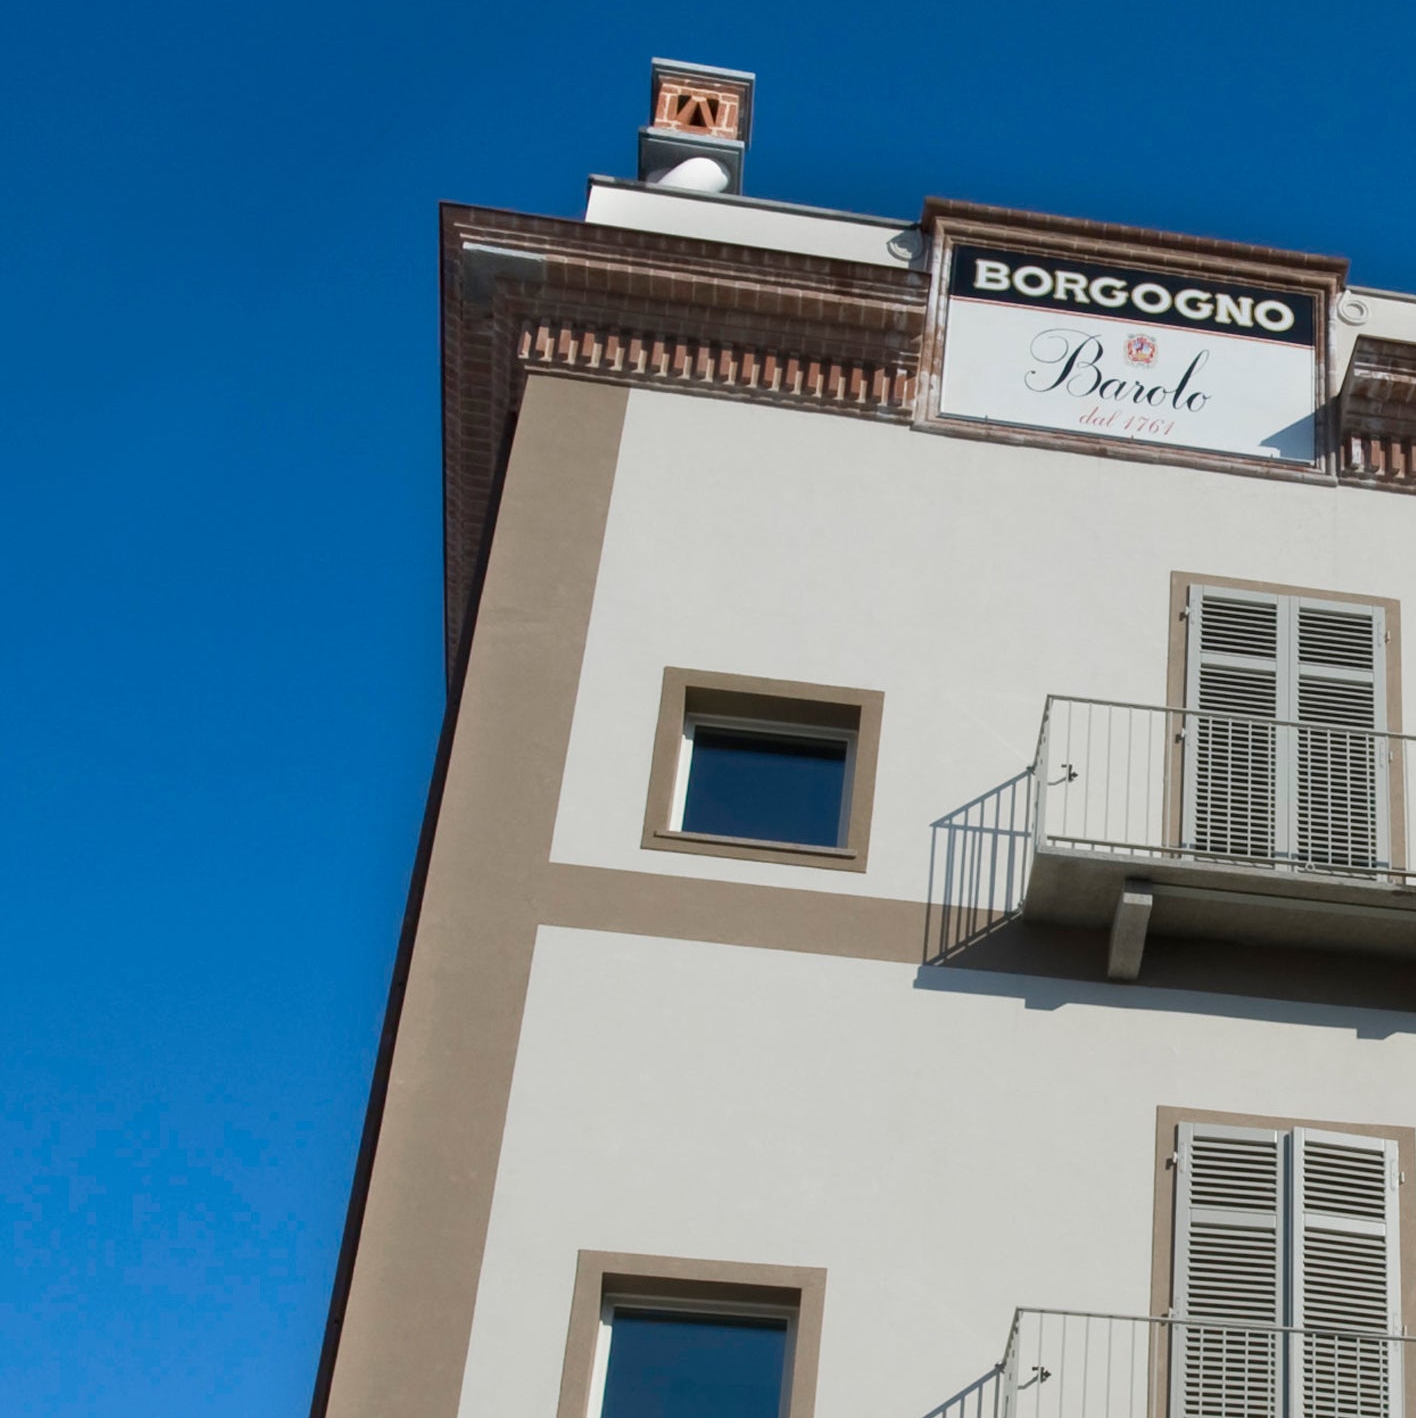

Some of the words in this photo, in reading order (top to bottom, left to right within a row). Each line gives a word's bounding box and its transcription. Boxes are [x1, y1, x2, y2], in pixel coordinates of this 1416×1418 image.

[973, 258, 1295, 332] BORGOGNO
[1024, 327, 1211, 413] Barolo
[1079, 406, 1116, 428] dal
[1123, 412, 1175, 436] 1761
